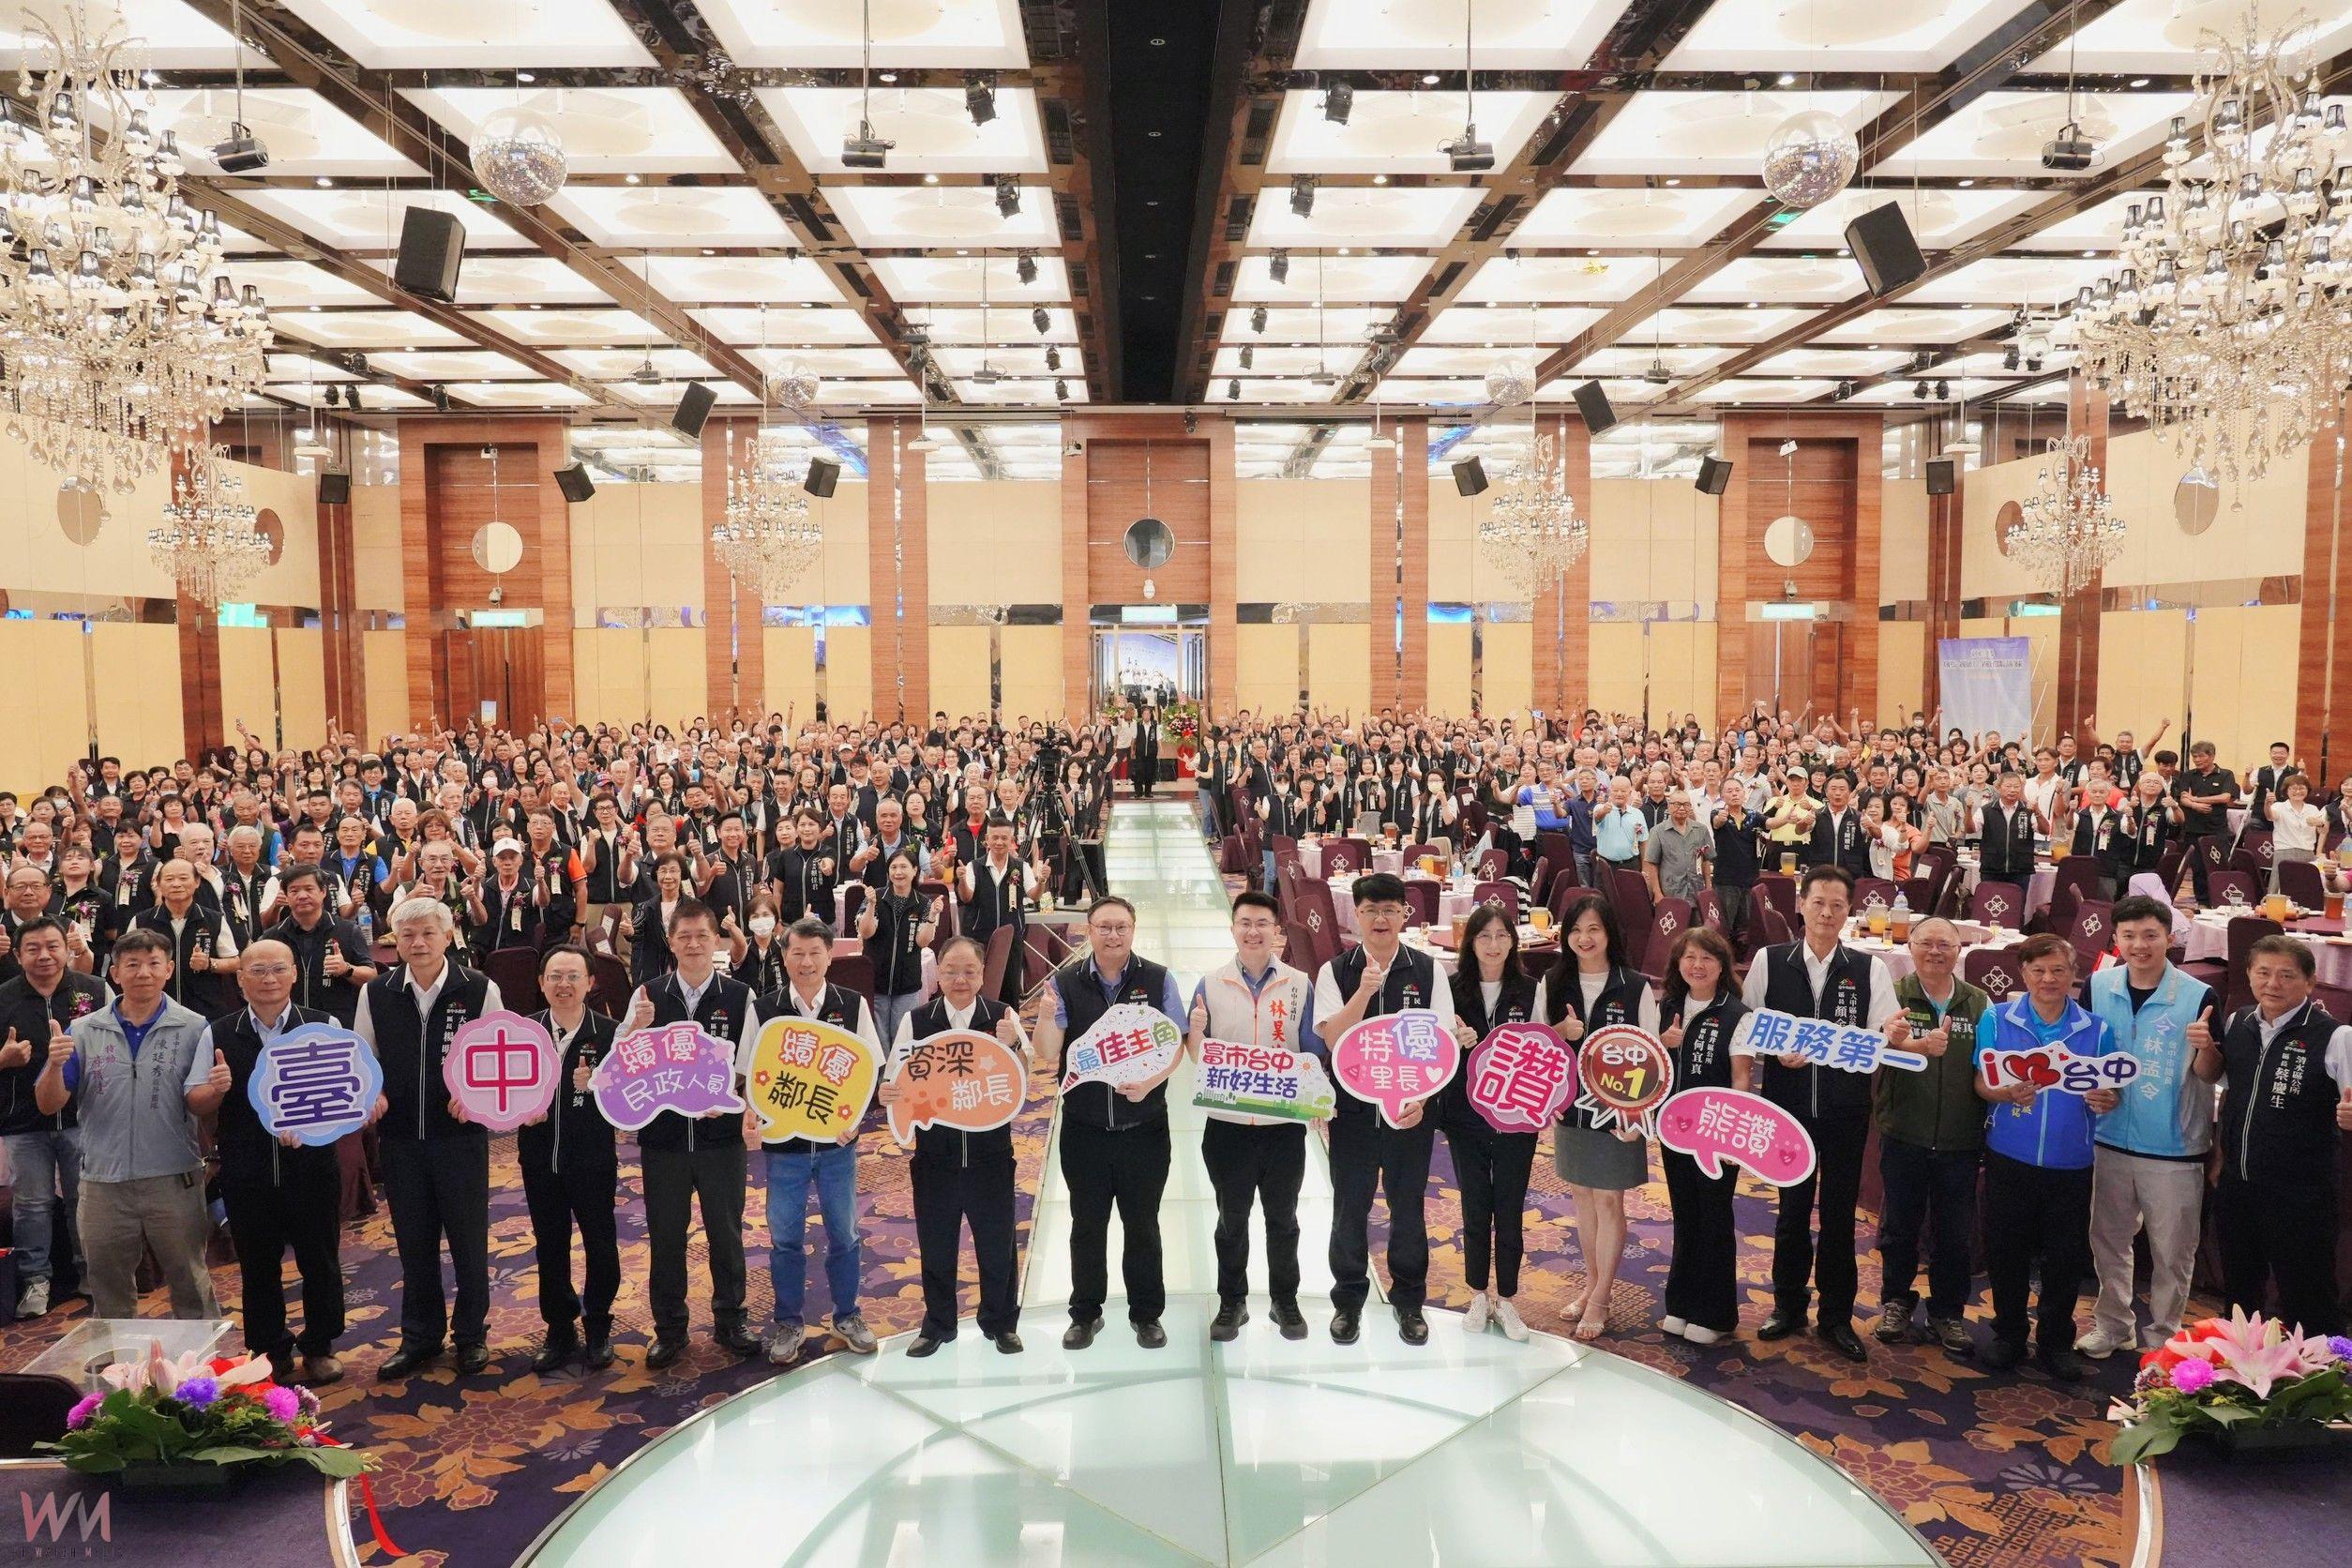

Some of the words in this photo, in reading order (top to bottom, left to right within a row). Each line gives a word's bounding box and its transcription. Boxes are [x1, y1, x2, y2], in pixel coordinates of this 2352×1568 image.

[1077, 1020, 1178, 1071] 最佳主角
[1269, 999, 1289, 1048] 林昊
[1359, 1010, 1440, 1063] 特優
[1746, 1013, 1922, 1068] 服務第一
[465, 1029, 539, 1112] 中
[618, 1027, 699, 1074] 績優
[778, 1029, 860, 1084] 績優
[899, 1041, 975, 1081] 資深
[1202, 1041, 1295, 1074] 富市台中
[1601, 1043, 1648, 1066] 台中
[1983, 1052, 2000, 1086] i
[2063, 1057, 2137, 1092] 台中
[269, 1041, 364, 1128] 臺
[622, 1068, 726, 1112] 民政人員
[767, 1070, 839, 1125] 鄰長
[951, 1072, 1014, 1112] 鄰長
[1206, 1065, 1298, 1099] 新好生活
[1370, 1065, 1421, 1093] 里長
[1475, 1032, 1566, 1125] 讚
[2289, 1055, 2307, 1095] 清水區公所
[1696, 1095, 1778, 1159] 熊讚
